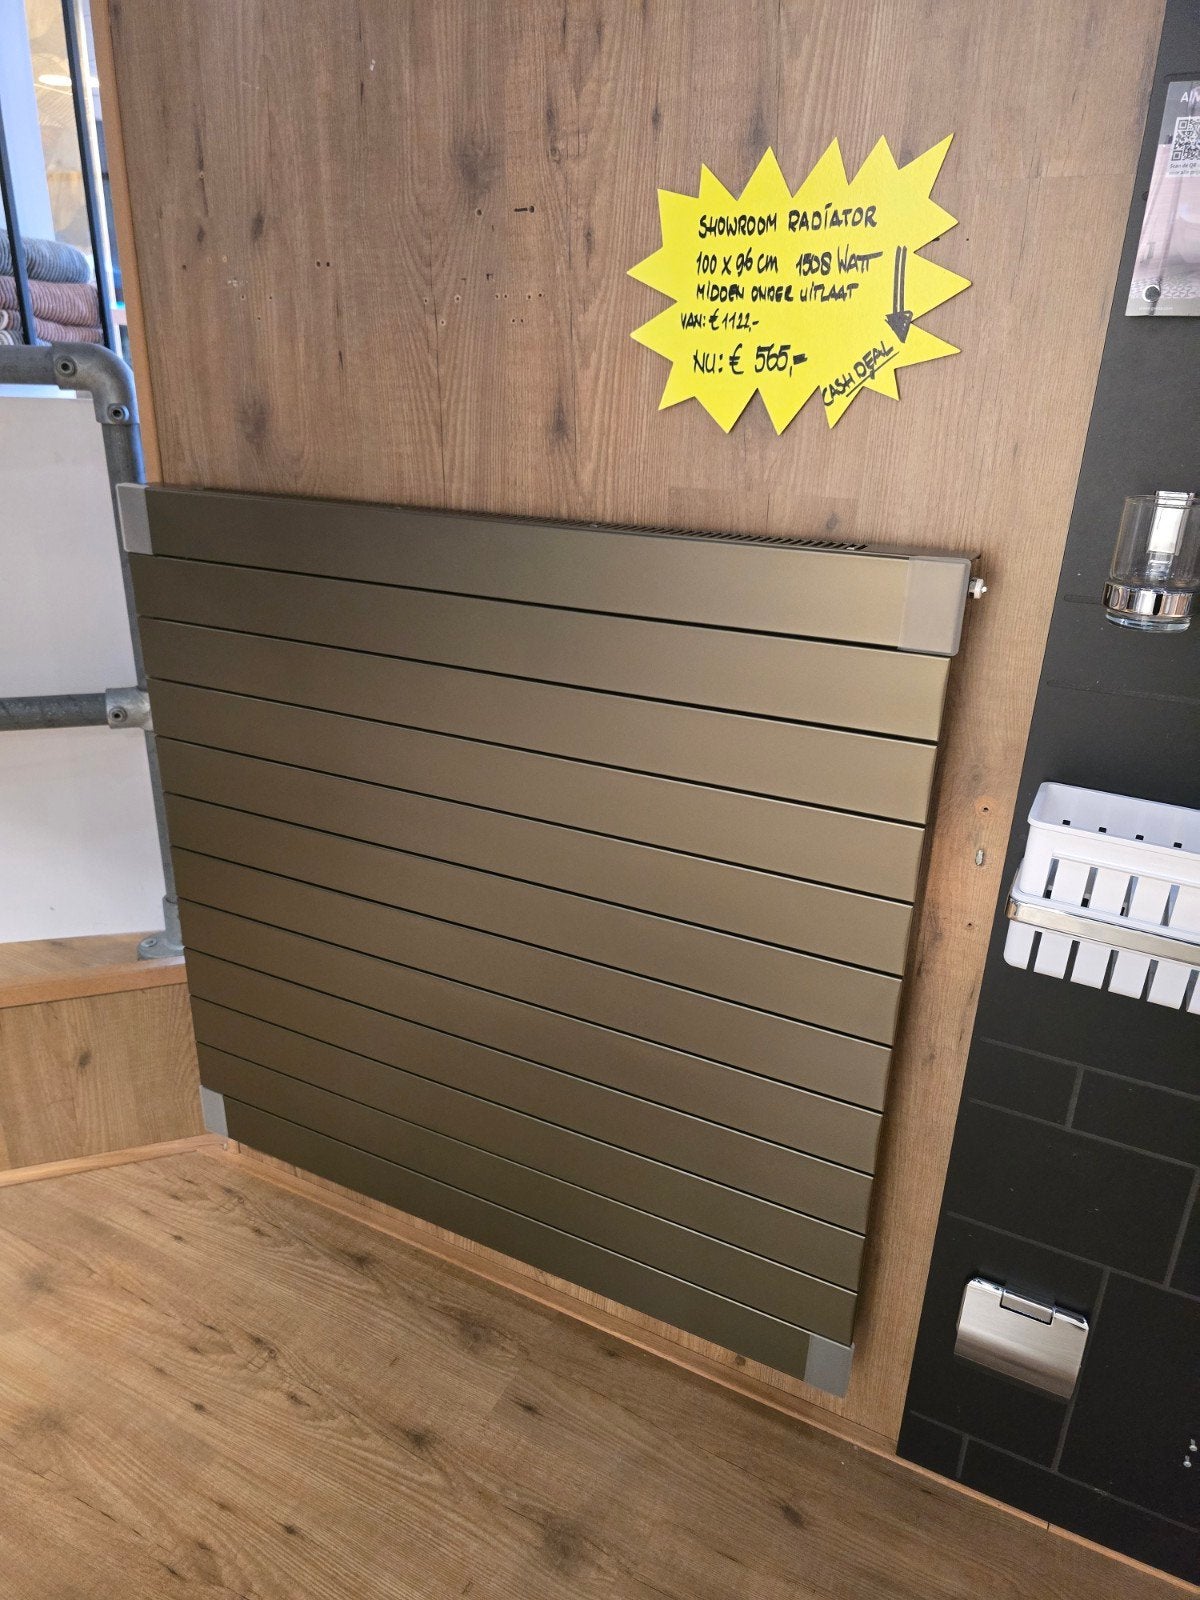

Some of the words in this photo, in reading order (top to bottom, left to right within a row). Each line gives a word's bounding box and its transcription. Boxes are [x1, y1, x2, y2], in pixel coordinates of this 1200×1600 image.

[698, 212, 777, 239] SHOWROOM
[696, 251, 717, 276] 100
[735, 247, 754, 277] 96
[795, 251, 832, 277] 1508
[751, 284, 794, 303] ONDER
[680, 312, 706, 330] VAN:
[693, 349, 724, 375] NU:
[729, 343, 744, 375] €
[821, 372, 856, 407] CASH
[853, 341, 895, 380] DEAL
